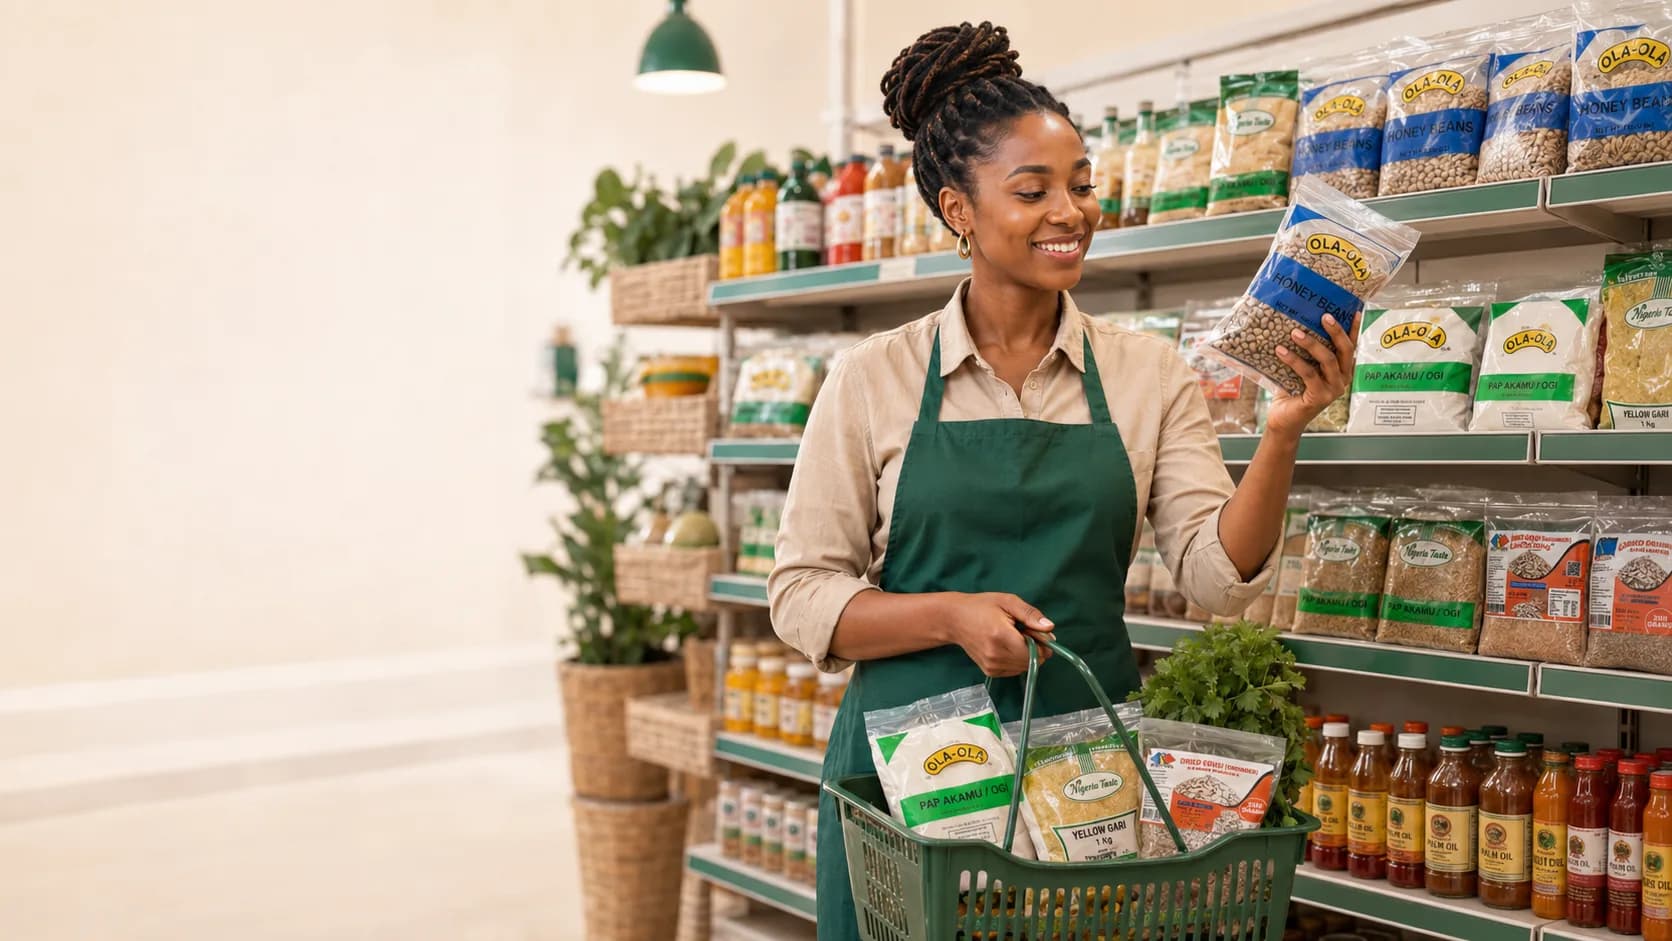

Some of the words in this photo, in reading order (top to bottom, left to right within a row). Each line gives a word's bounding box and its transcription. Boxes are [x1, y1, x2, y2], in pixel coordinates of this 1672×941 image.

[1601, 43, 1667, 68] OLA-OLA
[1404, 74, 1462, 99] OLA-OLA
[1515, 102, 1554, 116] BEANS
[1579, 99, 1628, 117] HONEY
[1387, 127, 1426, 143] HONEY
[1430, 120, 1474, 135] BEANS
[1310, 238, 1367, 278] OLA-OLA
[1272, 272, 1317, 301] HONEY
[1631, 303, 1662, 322] Nigeria
[1506, 332, 1554, 350] OLA-OLA
[1365, 372, 1381, 381] PAP
[1382, 371, 1418, 381] AKAMU
[1426, 371, 1444, 380] OGI
[1488, 382, 1502, 390] PAP
[1504, 381, 1534, 390] AKAMU
[1541, 381, 1558, 390] OGI
[1624, 410, 1650, 418] YELLOW
[1652, 410, 1669, 418] GARI
[1443, 608, 1460, 617] OGI
[927, 747, 984, 771] OLA-OLA
[1069, 779, 1099, 796] Nigeria
[919, 798, 940, 811] PAP
[943, 788, 983, 805] AKAMU
[991, 783, 1009, 794] OGI
[1072, 825, 1106, 840] YELLOW
[1107, 820, 1127, 832] GARI
[1096, 838, 1100, 846] 1
[1446, 843, 1458, 851] OIL
[1500, 852, 1513, 861] OIL
